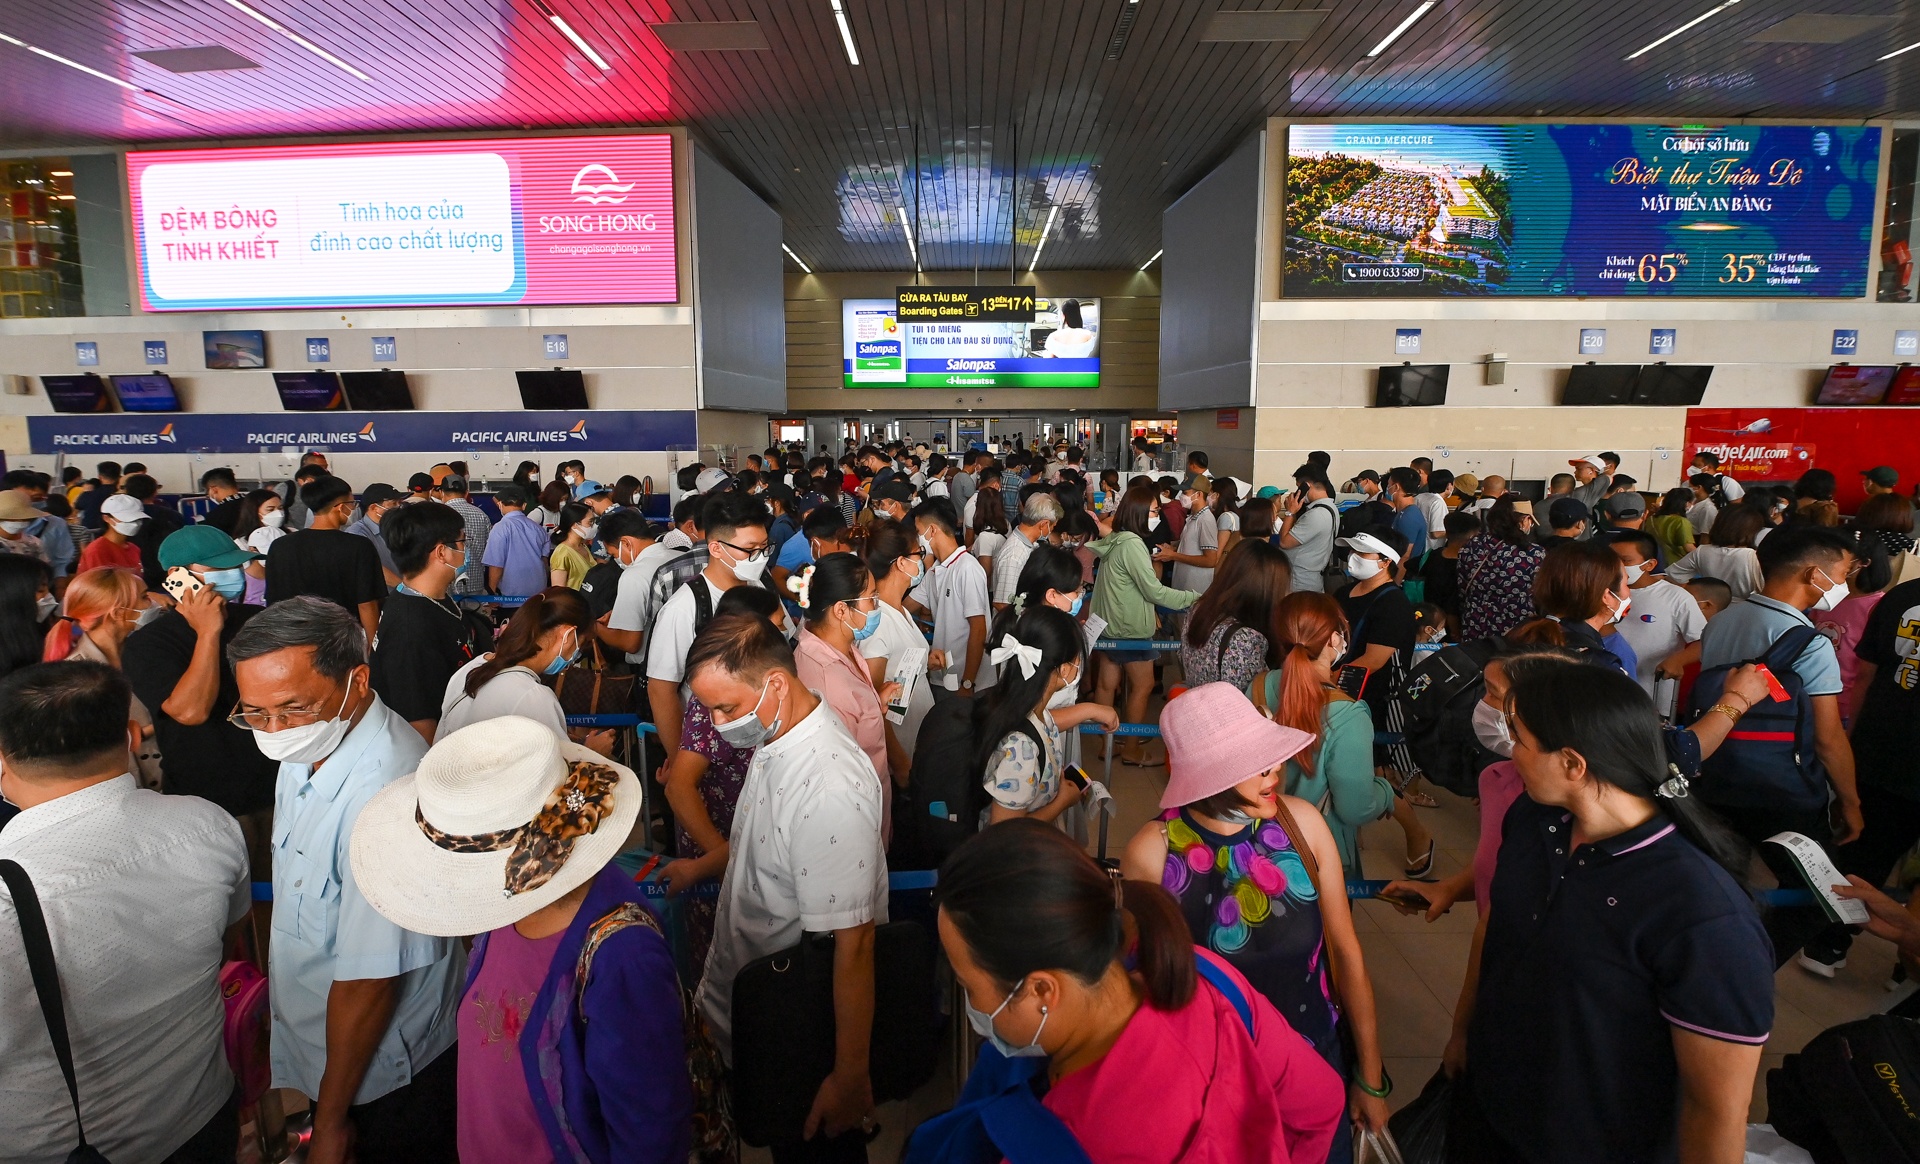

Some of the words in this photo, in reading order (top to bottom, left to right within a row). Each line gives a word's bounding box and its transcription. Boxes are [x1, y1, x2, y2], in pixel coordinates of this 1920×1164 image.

[1345, 135, 1381, 145] GRAND
[1384, 135, 1434, 145] MERCURE
[1684, 136, 1705, 154] hội
[1707, 158, 1761, 190] Triệu
[1641, 194, 1673, 214] MẶT
[1675, 191, 1706, 212] BIỂN
[1708, 197, 1730, 212] AN
[339, 201, 380, 222] Tinh
[385, 201, 422, 221] hoa
[427, 198, 464, 220] của
[160, 207, 207, 236] ĐỆM
[538, 215, 594, 233] SONG
[356, 235, 393, 251] cao
[399, 226, 443, 250] chất
[449, 228, 503, 253] lượng
[1360, 267, 1381, 278] 1900
[1383, 267, 1400, 278] 633
[1401, 267, 1419, 278] 589
[1638, 253, 1689, 283] 65%
[1718, 253, 1766, 283] 35%
[900, 292, 918, 303] CỬA
[920, 293, 932, 302] RA
[933, 292, 950, 303] TÀU
[951, 293, 968, 302] BAY
[981, 297, 995, 311] 13
[1007, 297, 1021, 311] 17
[900, 306, 938, 317] Boarding
[939, 306, 963, 316] Gates
[927, 325, 936, 333] 10
[546, 341, 566, 353] E18
[930, 337, 945, 345] CHO
[1399, 336, 1419, 347] E19
[1583, 336, 1603, 348] E20
[1653, 336, 1673, 348] E21
[1835, 336, 1856, 348] E22
[1897, 337, 1917, 349] E23
[77, 347, 97, 360] E14
[146, 347, 166, 359] E15
[309, 344, 328, 356] E16
[375, 343, 393, 355] E17
[859, 344, 898, 355] Salonpas
[946, 358, 996, 373] Salonpas
[53, 434, 100, 445] PACIFIC
[100, 433, 158, 445] AIRLINES
[247, 432, 296, 444] PACIFIC
[297, 432, 357, 444] AIRLINES
[452, 431, 504, 443] PACIFIC
[505, 430, 567, 443] AIRLINES
